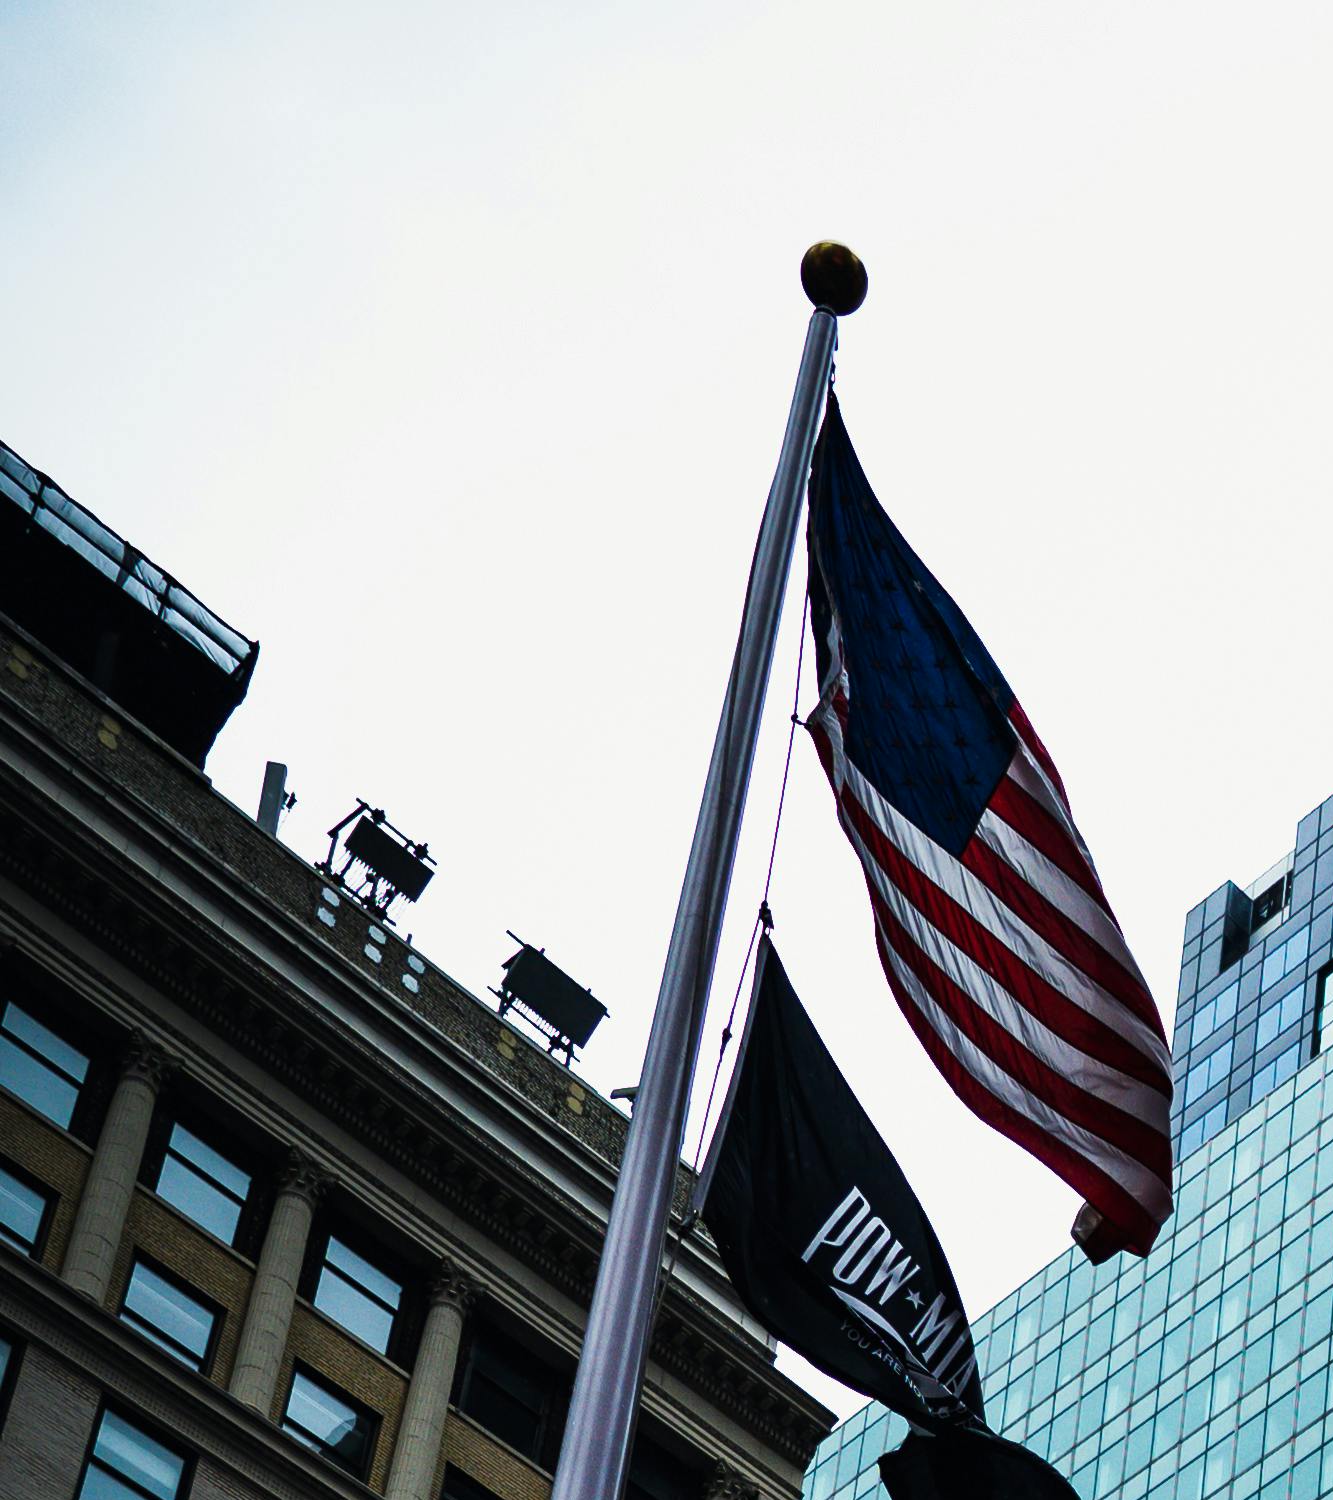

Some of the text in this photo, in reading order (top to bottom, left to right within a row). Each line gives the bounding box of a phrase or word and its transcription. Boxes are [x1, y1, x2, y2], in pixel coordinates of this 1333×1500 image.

[802, 1186, 978, 1401] POW MIA
[839, 1318, 904, 1376] YOU ARE
